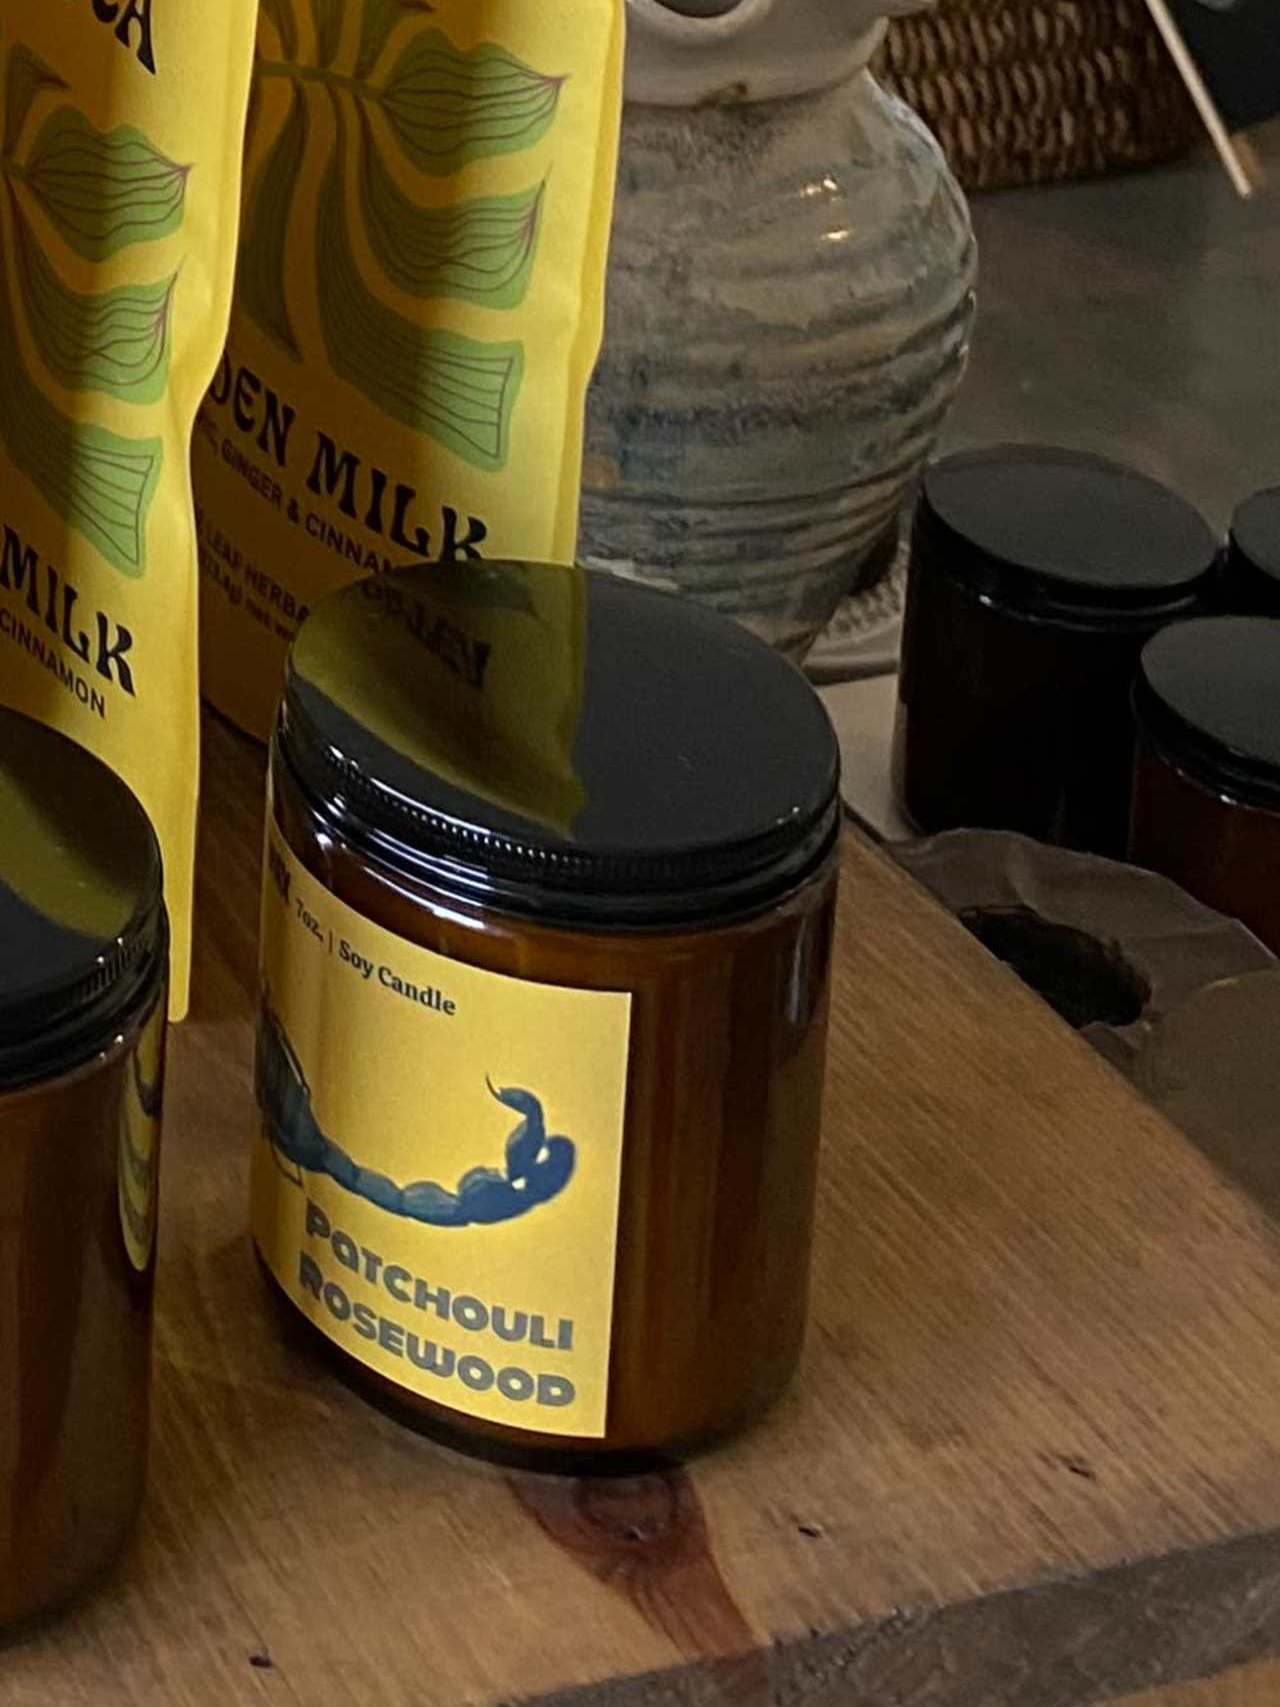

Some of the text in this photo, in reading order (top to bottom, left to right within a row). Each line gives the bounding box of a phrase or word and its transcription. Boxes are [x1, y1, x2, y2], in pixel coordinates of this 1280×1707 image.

[338, 937, 375, 980] Soy
[378, 965, 457, 1016] Candle
[298, 1249, 576, 1407] ROSEWOOD
[305, 1197, 574, 1351] PATCHOULI
